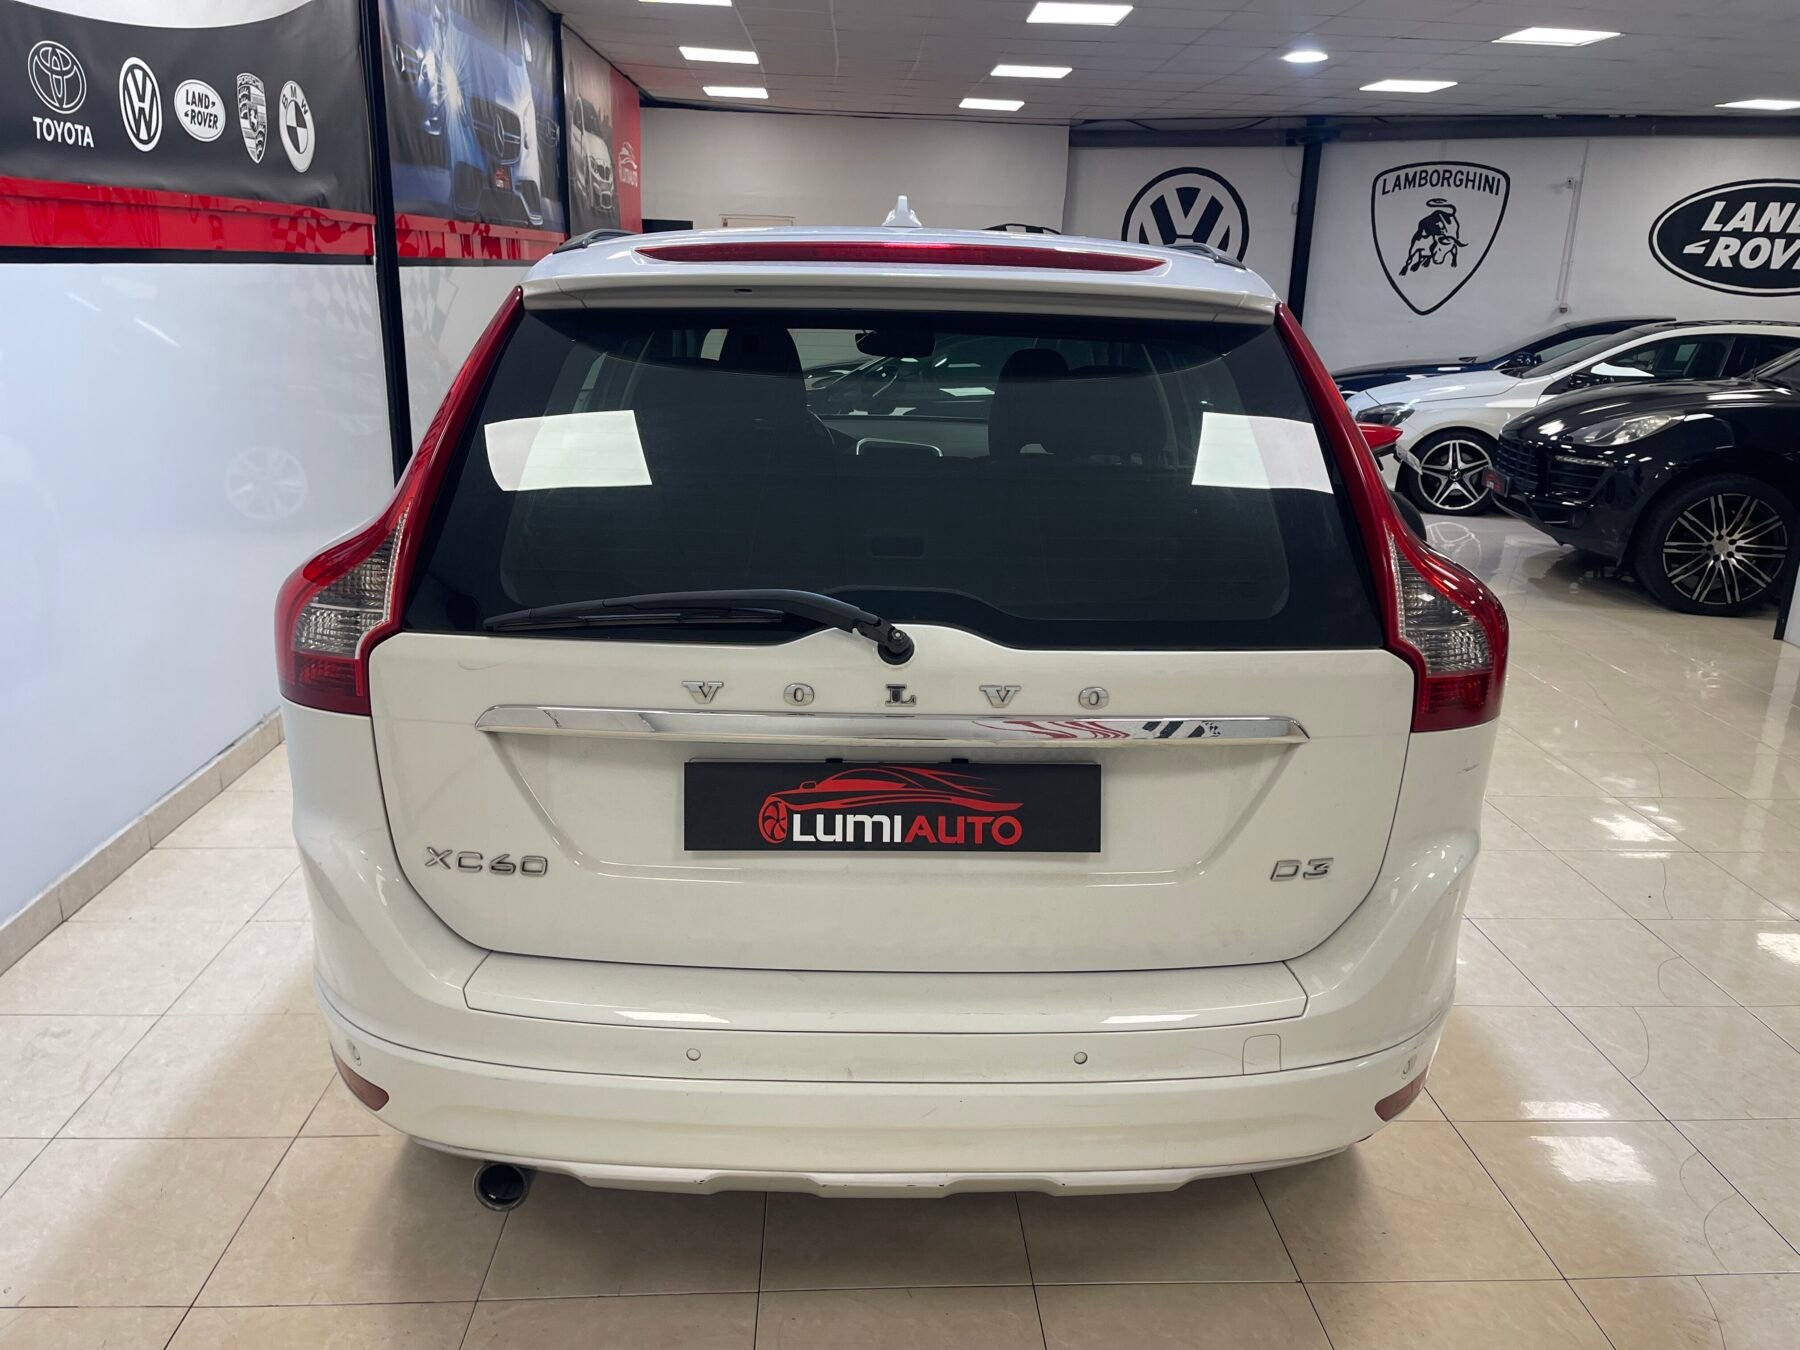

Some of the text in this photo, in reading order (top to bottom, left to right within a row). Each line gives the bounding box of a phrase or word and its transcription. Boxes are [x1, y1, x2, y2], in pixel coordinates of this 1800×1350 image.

[185, 89, 210, 109] LAND
[282, 85, 309, 115] BMW
[32, 116, 95, 148] TOYOTA
[190, 112, 219, 130] ROVER
[1381, 169, 1501, 196] LAMBORGHINI
[1703, 236, 1800, 270] ROV
[682, 680, 1110, 711] VOLVO
[424, 846, 549, 878] XC60
[1270, 857, 1334, 882] D3
